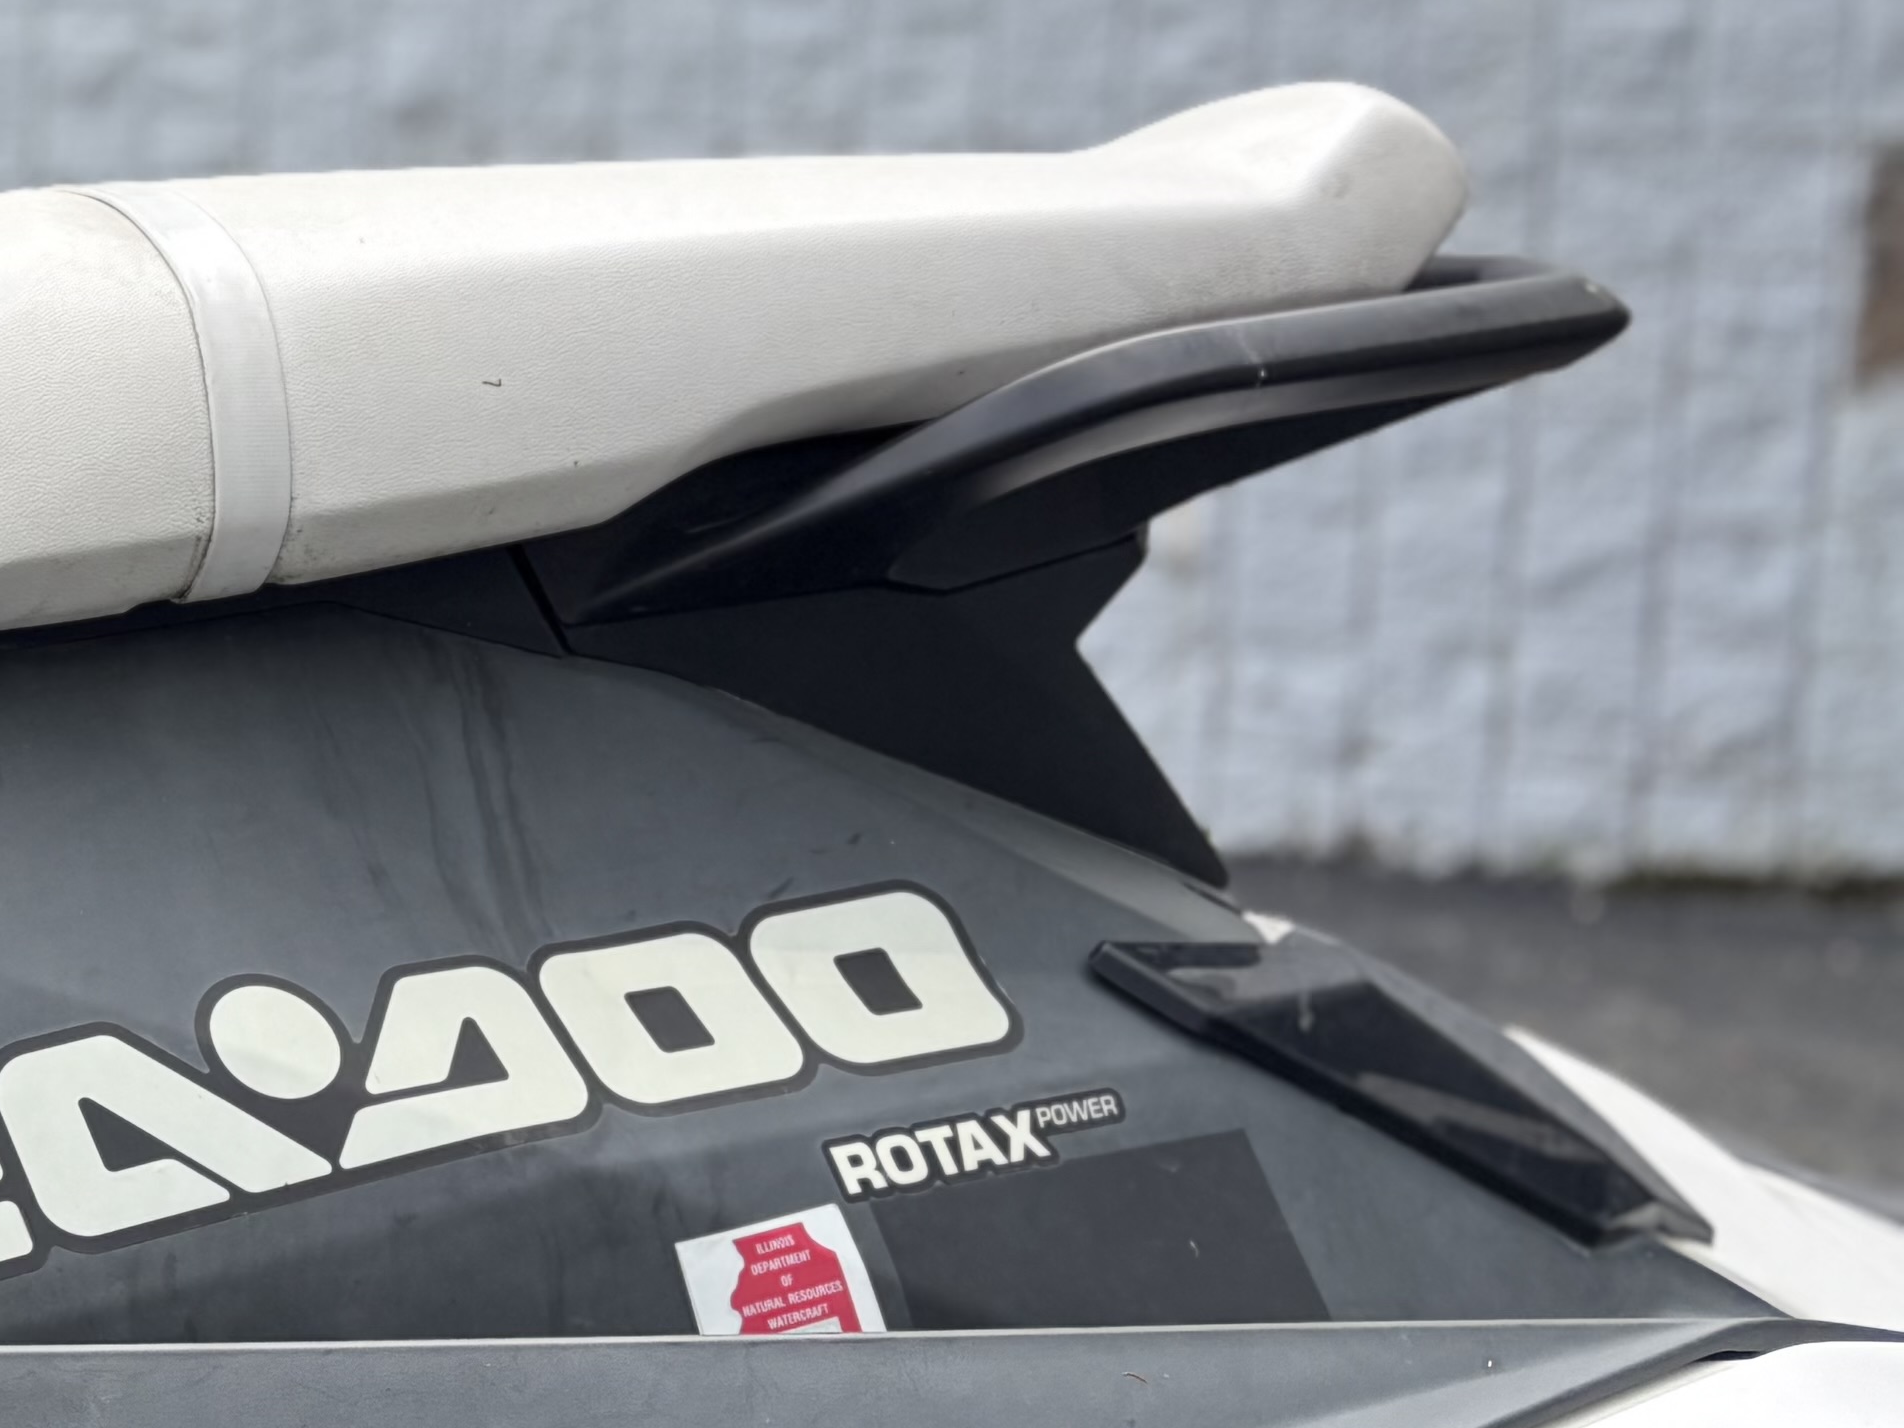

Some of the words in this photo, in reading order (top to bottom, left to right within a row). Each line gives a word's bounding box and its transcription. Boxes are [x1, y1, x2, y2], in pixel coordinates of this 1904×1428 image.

[829, 1109, 1052, 1195] ROTAX
[1035, 1095, 1118, 1129] POWER
[755, 1233, 796, 1255] ILLINOIS
[750, 1248, 811, 1276] DEPARTMENT
[780, 1273, 794, 1287] OF
[741, 1296, 786, 1318] NATURAL
[787, 1279, 844, 1305] RESOURCES
[767, 1302, 830, 1330] WATERCRAFT
